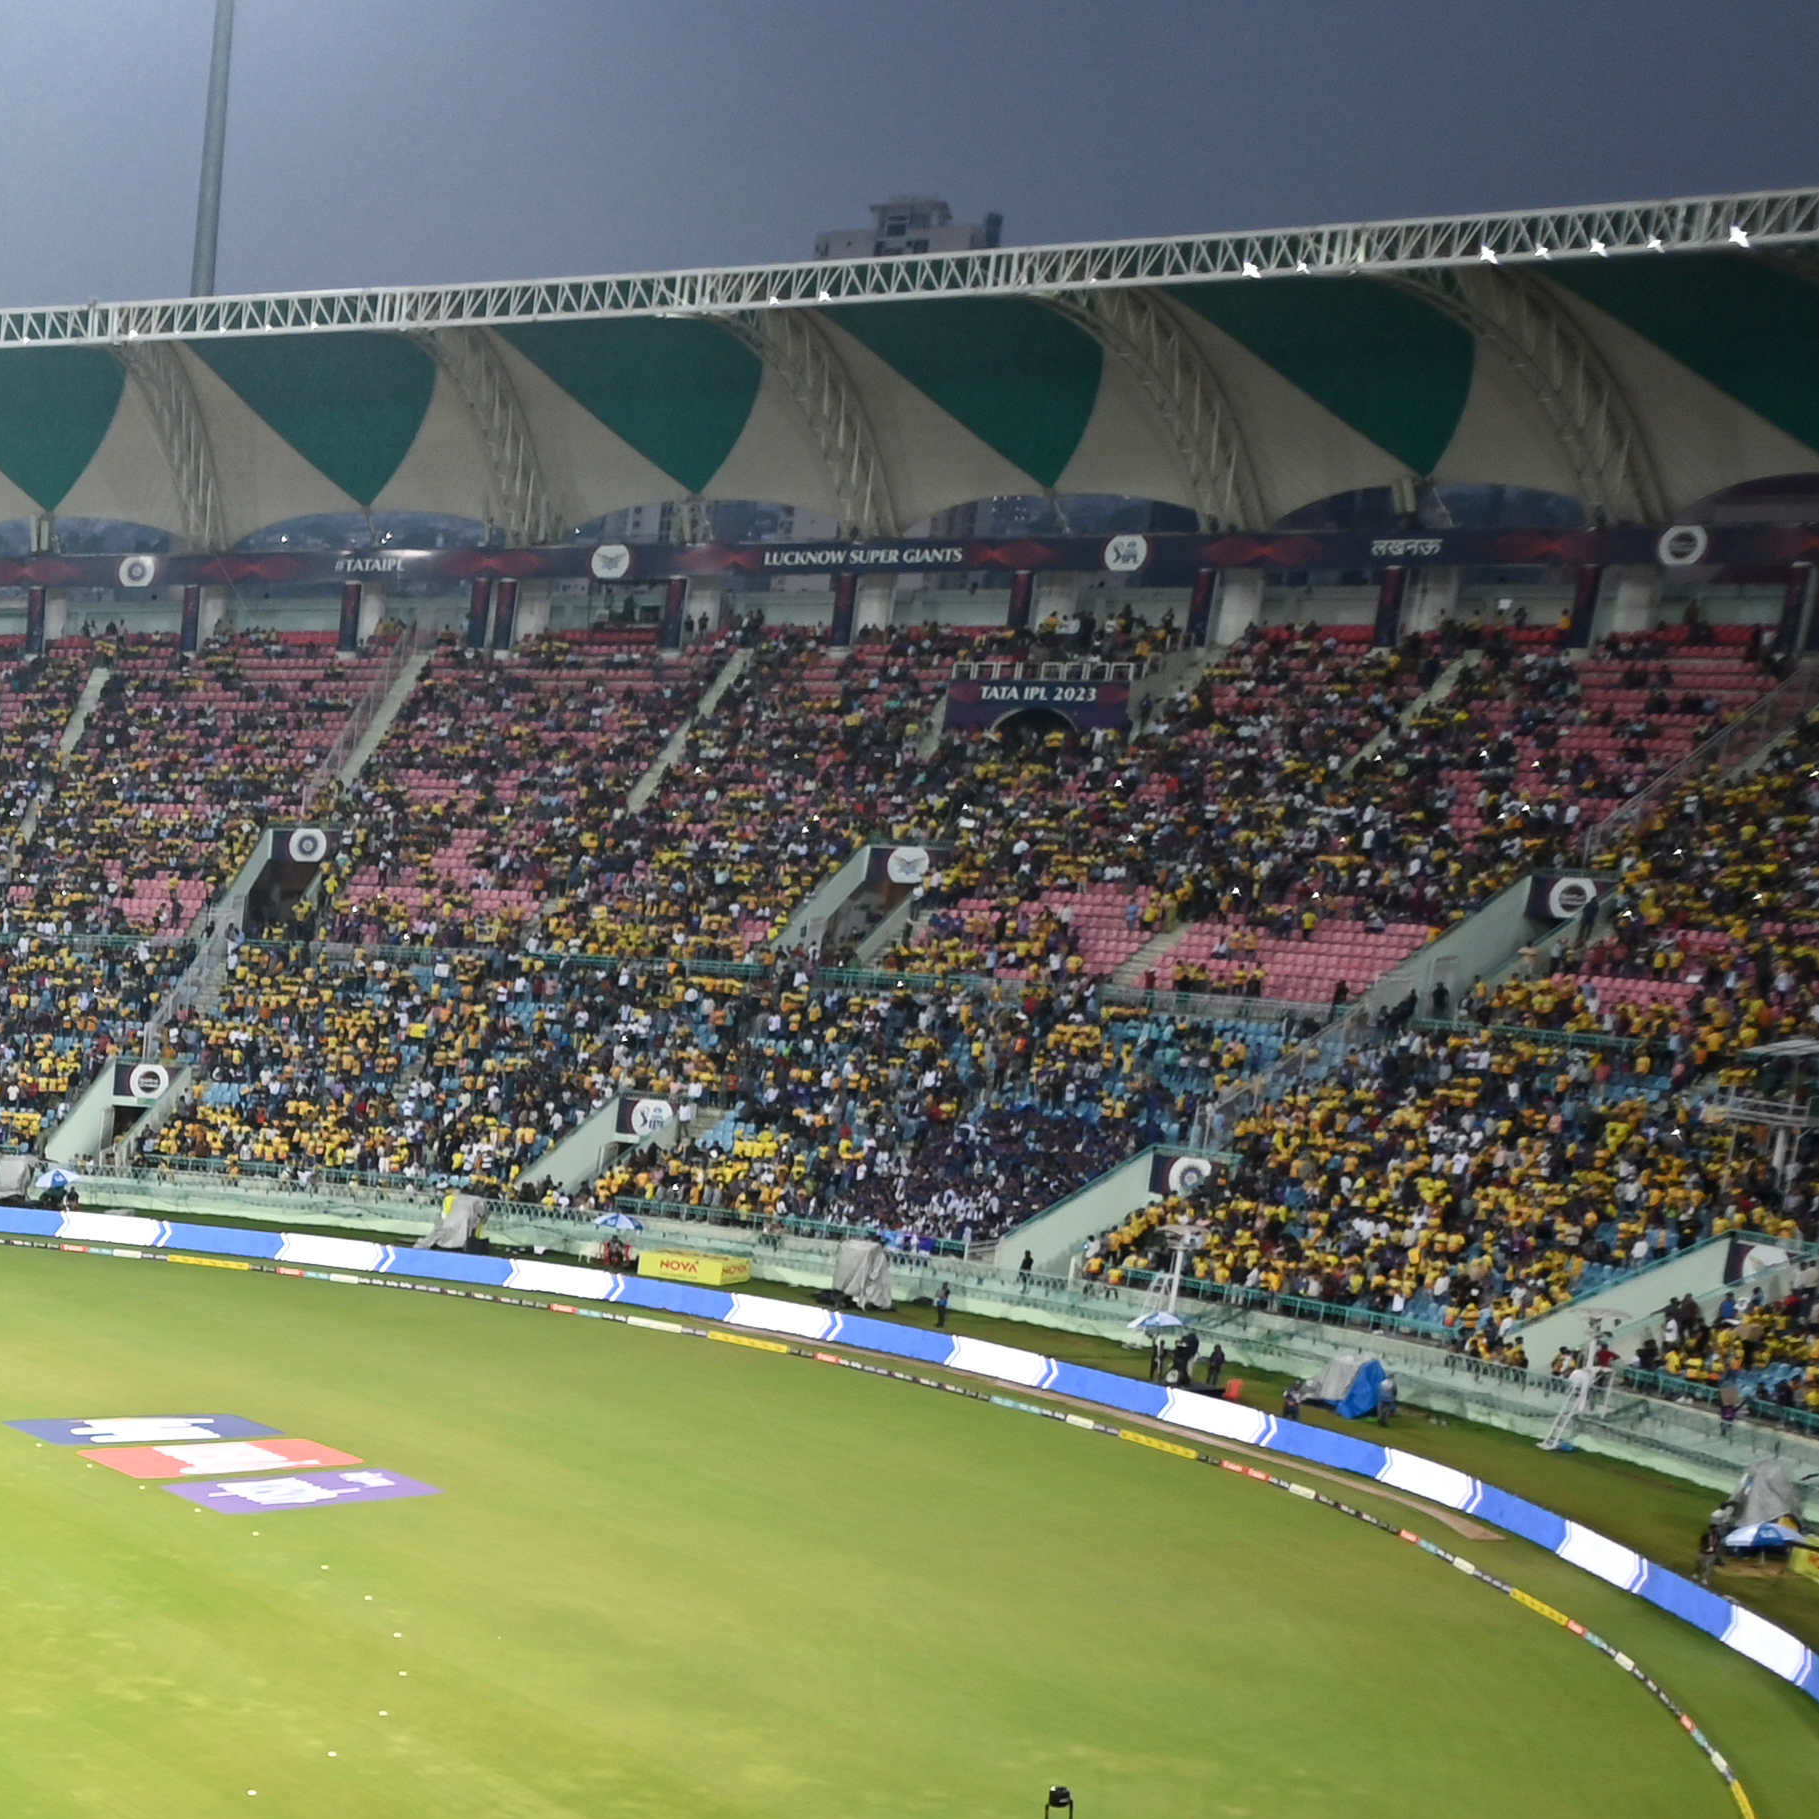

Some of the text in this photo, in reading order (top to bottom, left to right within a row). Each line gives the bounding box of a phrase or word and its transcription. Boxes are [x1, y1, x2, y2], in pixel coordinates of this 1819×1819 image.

[764, 547, 962, 566] LUCKNOW SUPER GIANTS
[335, 557, 405, 572] #TATAIPL
[980, 686, 1097, 701] TATA IPL 2023
[660, 1259, 698, 1273] NOVA
